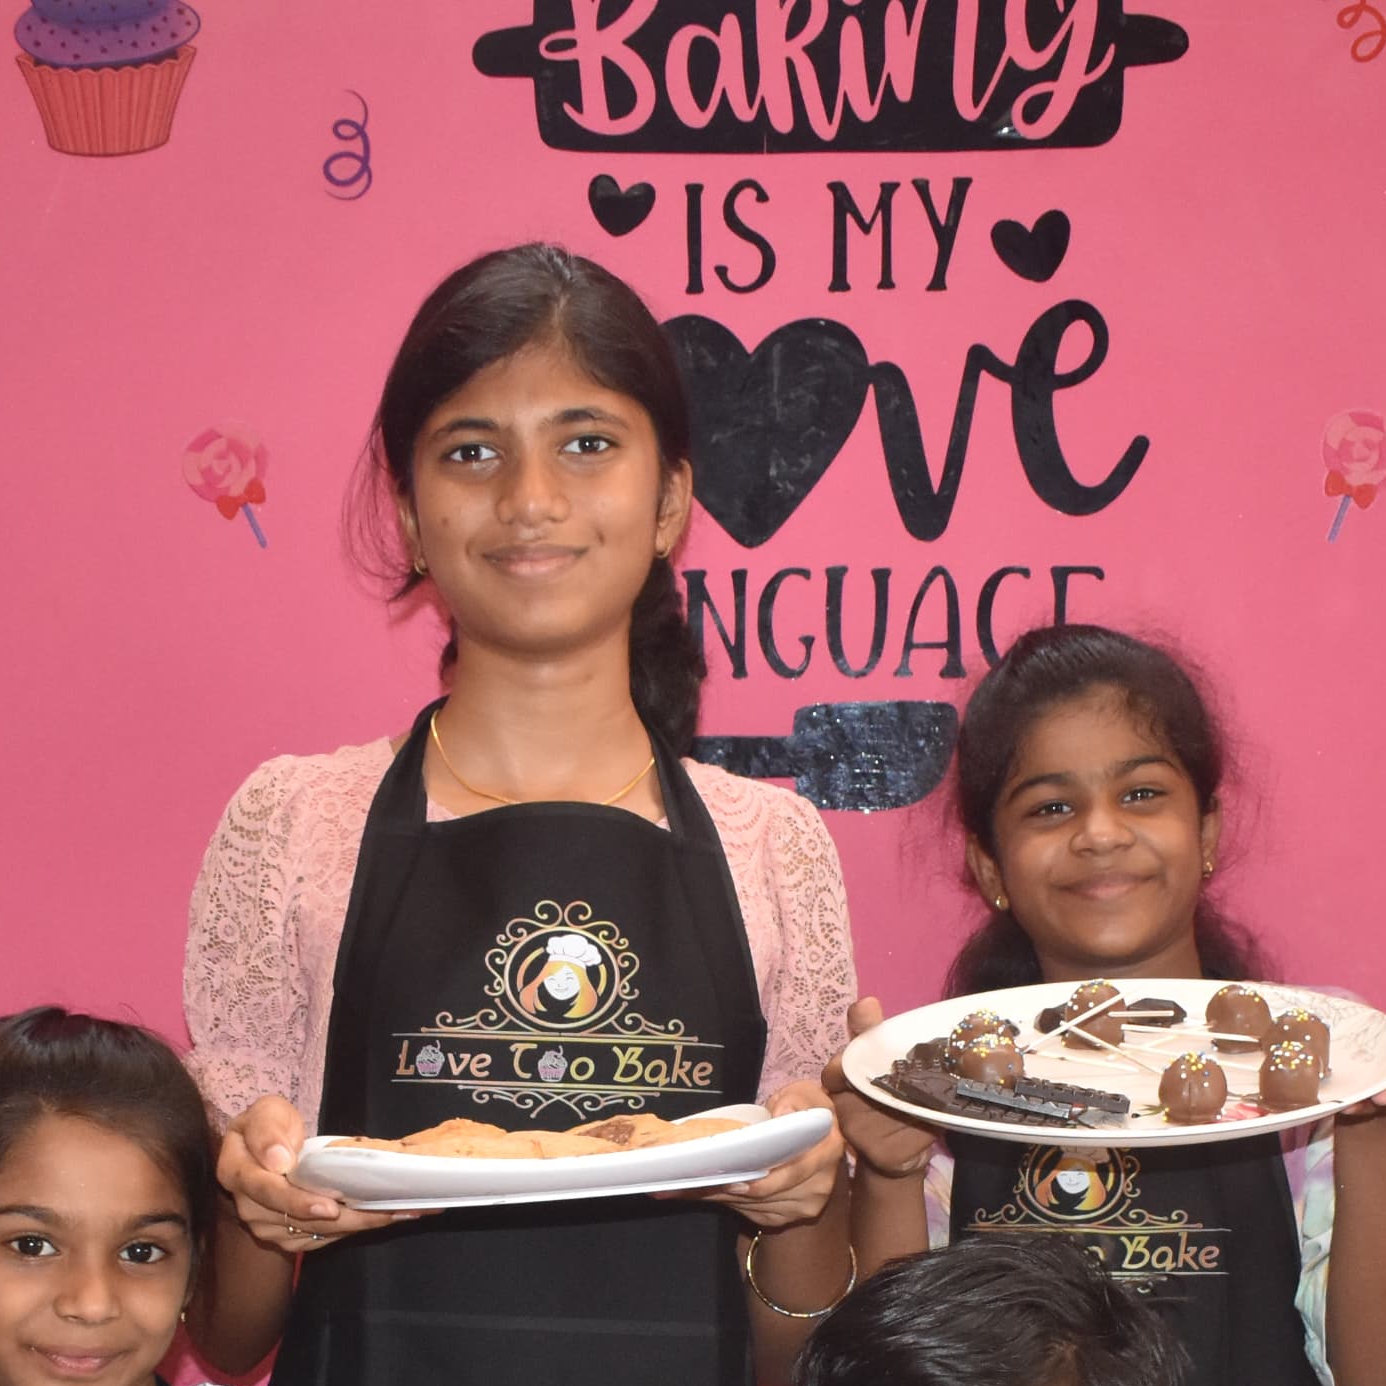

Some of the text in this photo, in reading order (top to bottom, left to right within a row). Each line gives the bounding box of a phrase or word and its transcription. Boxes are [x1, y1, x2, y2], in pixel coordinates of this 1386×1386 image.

[685, 177, 974, 294] IS MY
[612, 1044, 714, 1089] Bake
[1120, 1232, 1221, 1271] Bake
